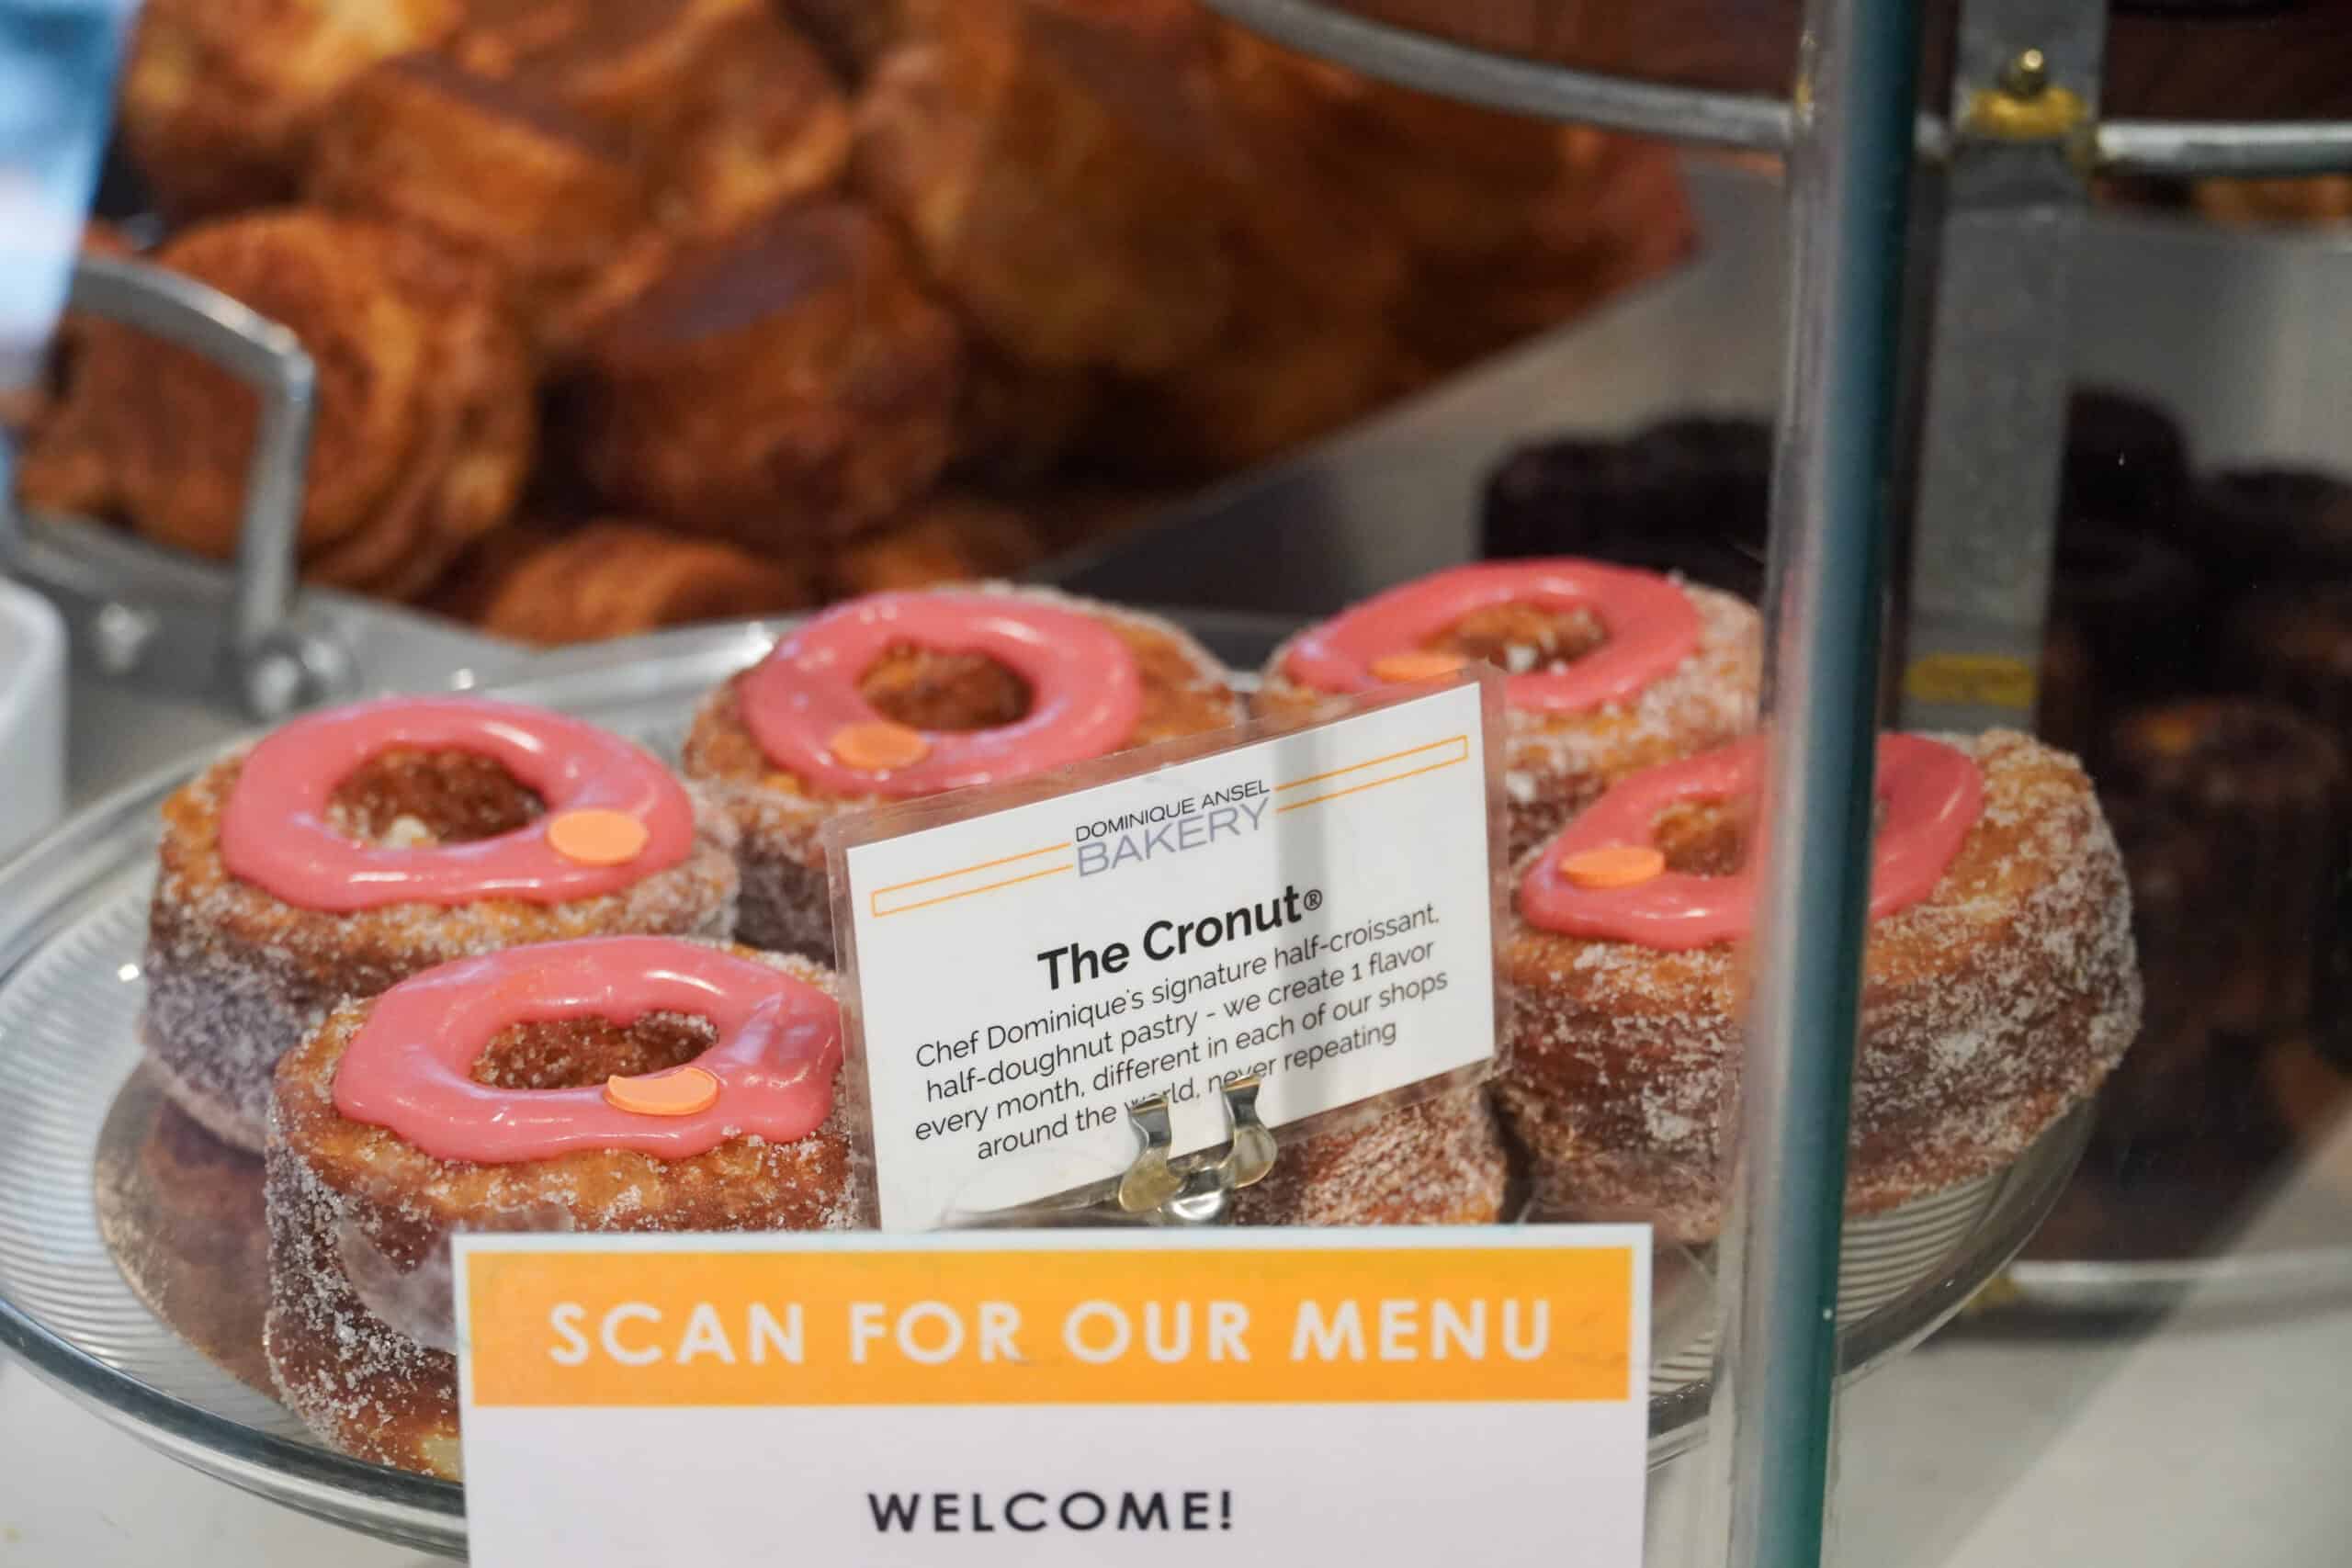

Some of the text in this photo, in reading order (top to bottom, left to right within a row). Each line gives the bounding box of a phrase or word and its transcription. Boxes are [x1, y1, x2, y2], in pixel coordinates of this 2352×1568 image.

[1076, 780, 1270, 841] DOMINIQUE ANSEL
[1078, 796, 1270, 877] BAKERY
[1037, 942, 1130, 991] The
[916, 1030, 980, 1067] Chef
[988, 988, 1145, 1051] Dominique's
[1151, 957, 1268, 1004] signature
[927, 1031, 1114, 1102] half-doughnut
[1121, 1011, 1198, 1055] pastry
[1223, 993, 1261, 1019] we
[1268, 969, 1344, 1006] create
[1351, 963, 1363, 983] 1
[1368, 942, 1434, 976] flavor
[915, 972, 1448, 1142] every month, different in each of our shops
[978, 1113, 1068, 1160] around
[1075, 1106, 1117, 1133] the
[1283, 1021, 1397, 1071] repeating
[550, 1298, 1551, 1365] SCAN FOR OUR MENU
[867, 1490, 1232, 1533] WELCOME!
